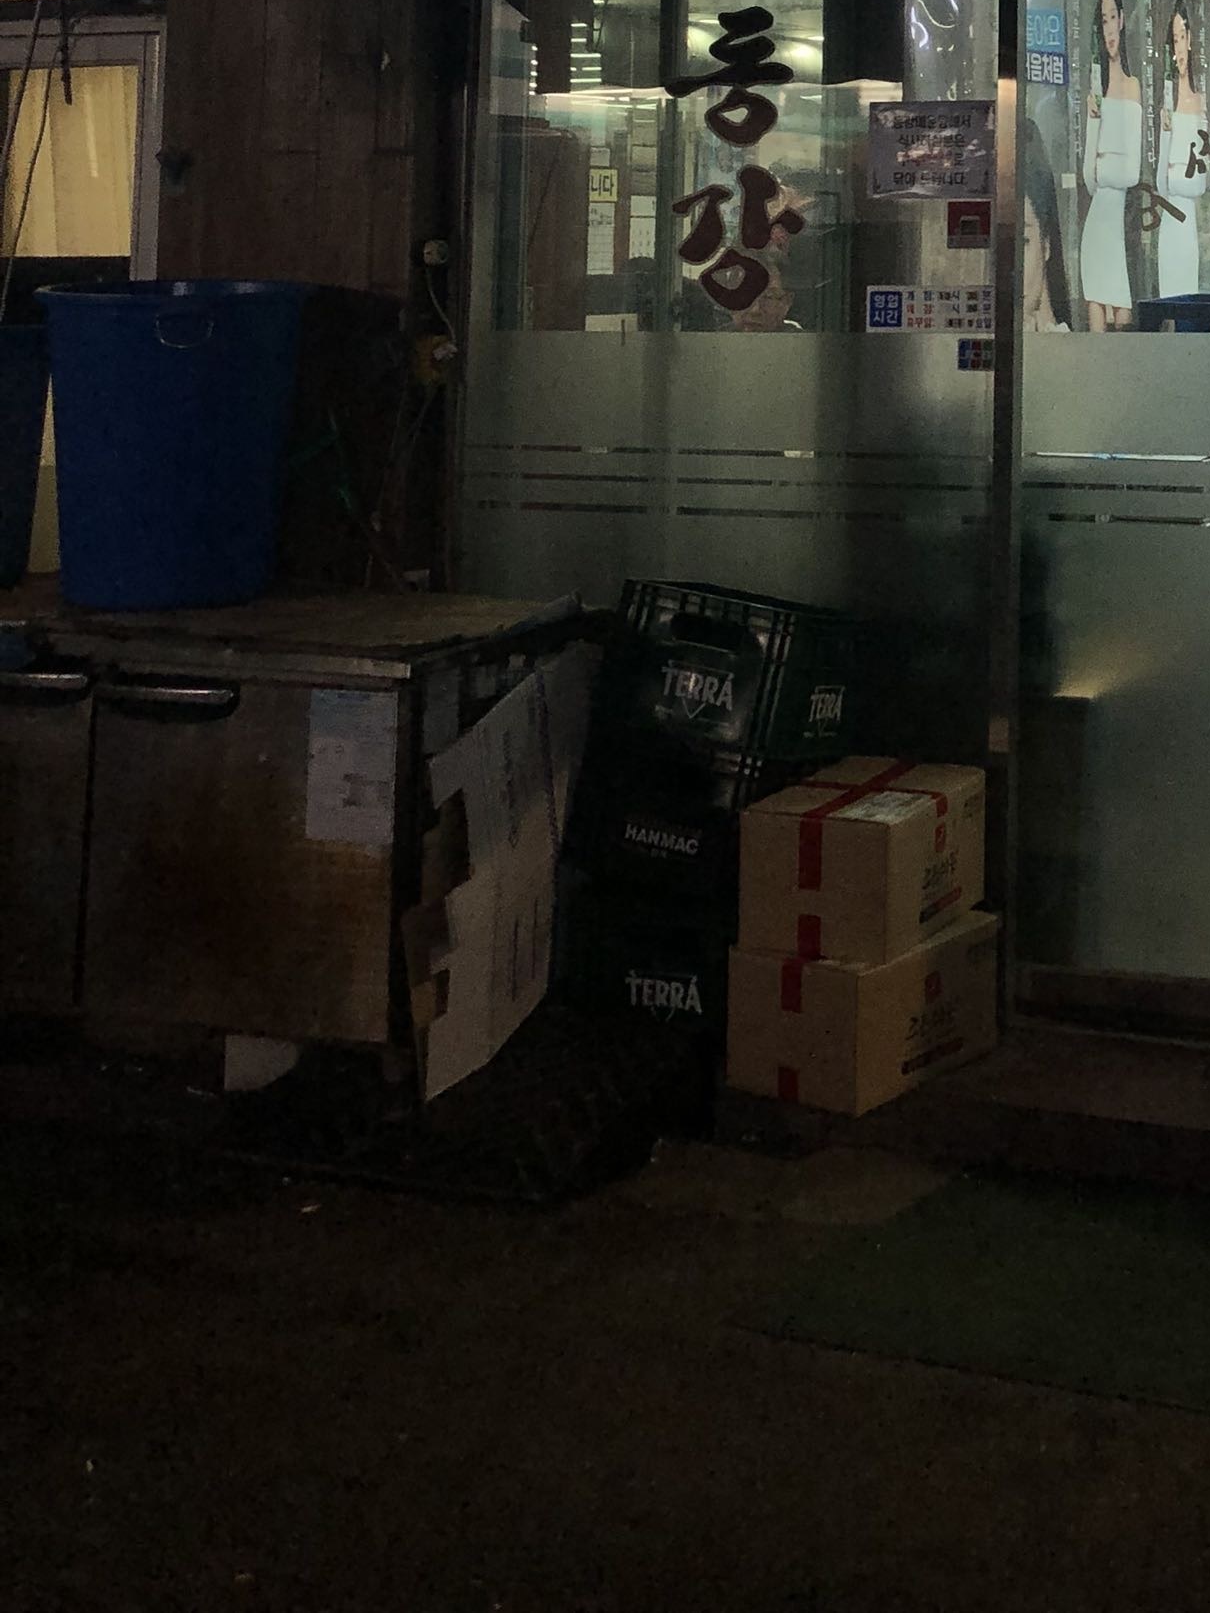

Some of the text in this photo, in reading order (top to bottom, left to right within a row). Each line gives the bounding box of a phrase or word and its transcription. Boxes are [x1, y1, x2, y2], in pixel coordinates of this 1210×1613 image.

[873, 292, 899, 308] 영업
[872, 308, 899, 325] 시간
[661, 663, 734, 711] TERRA
[808, 690, 844, 723] TERRA
[624, 823, 699, 855] HANMAC
[625, 969, 703, 1015] TERRA
